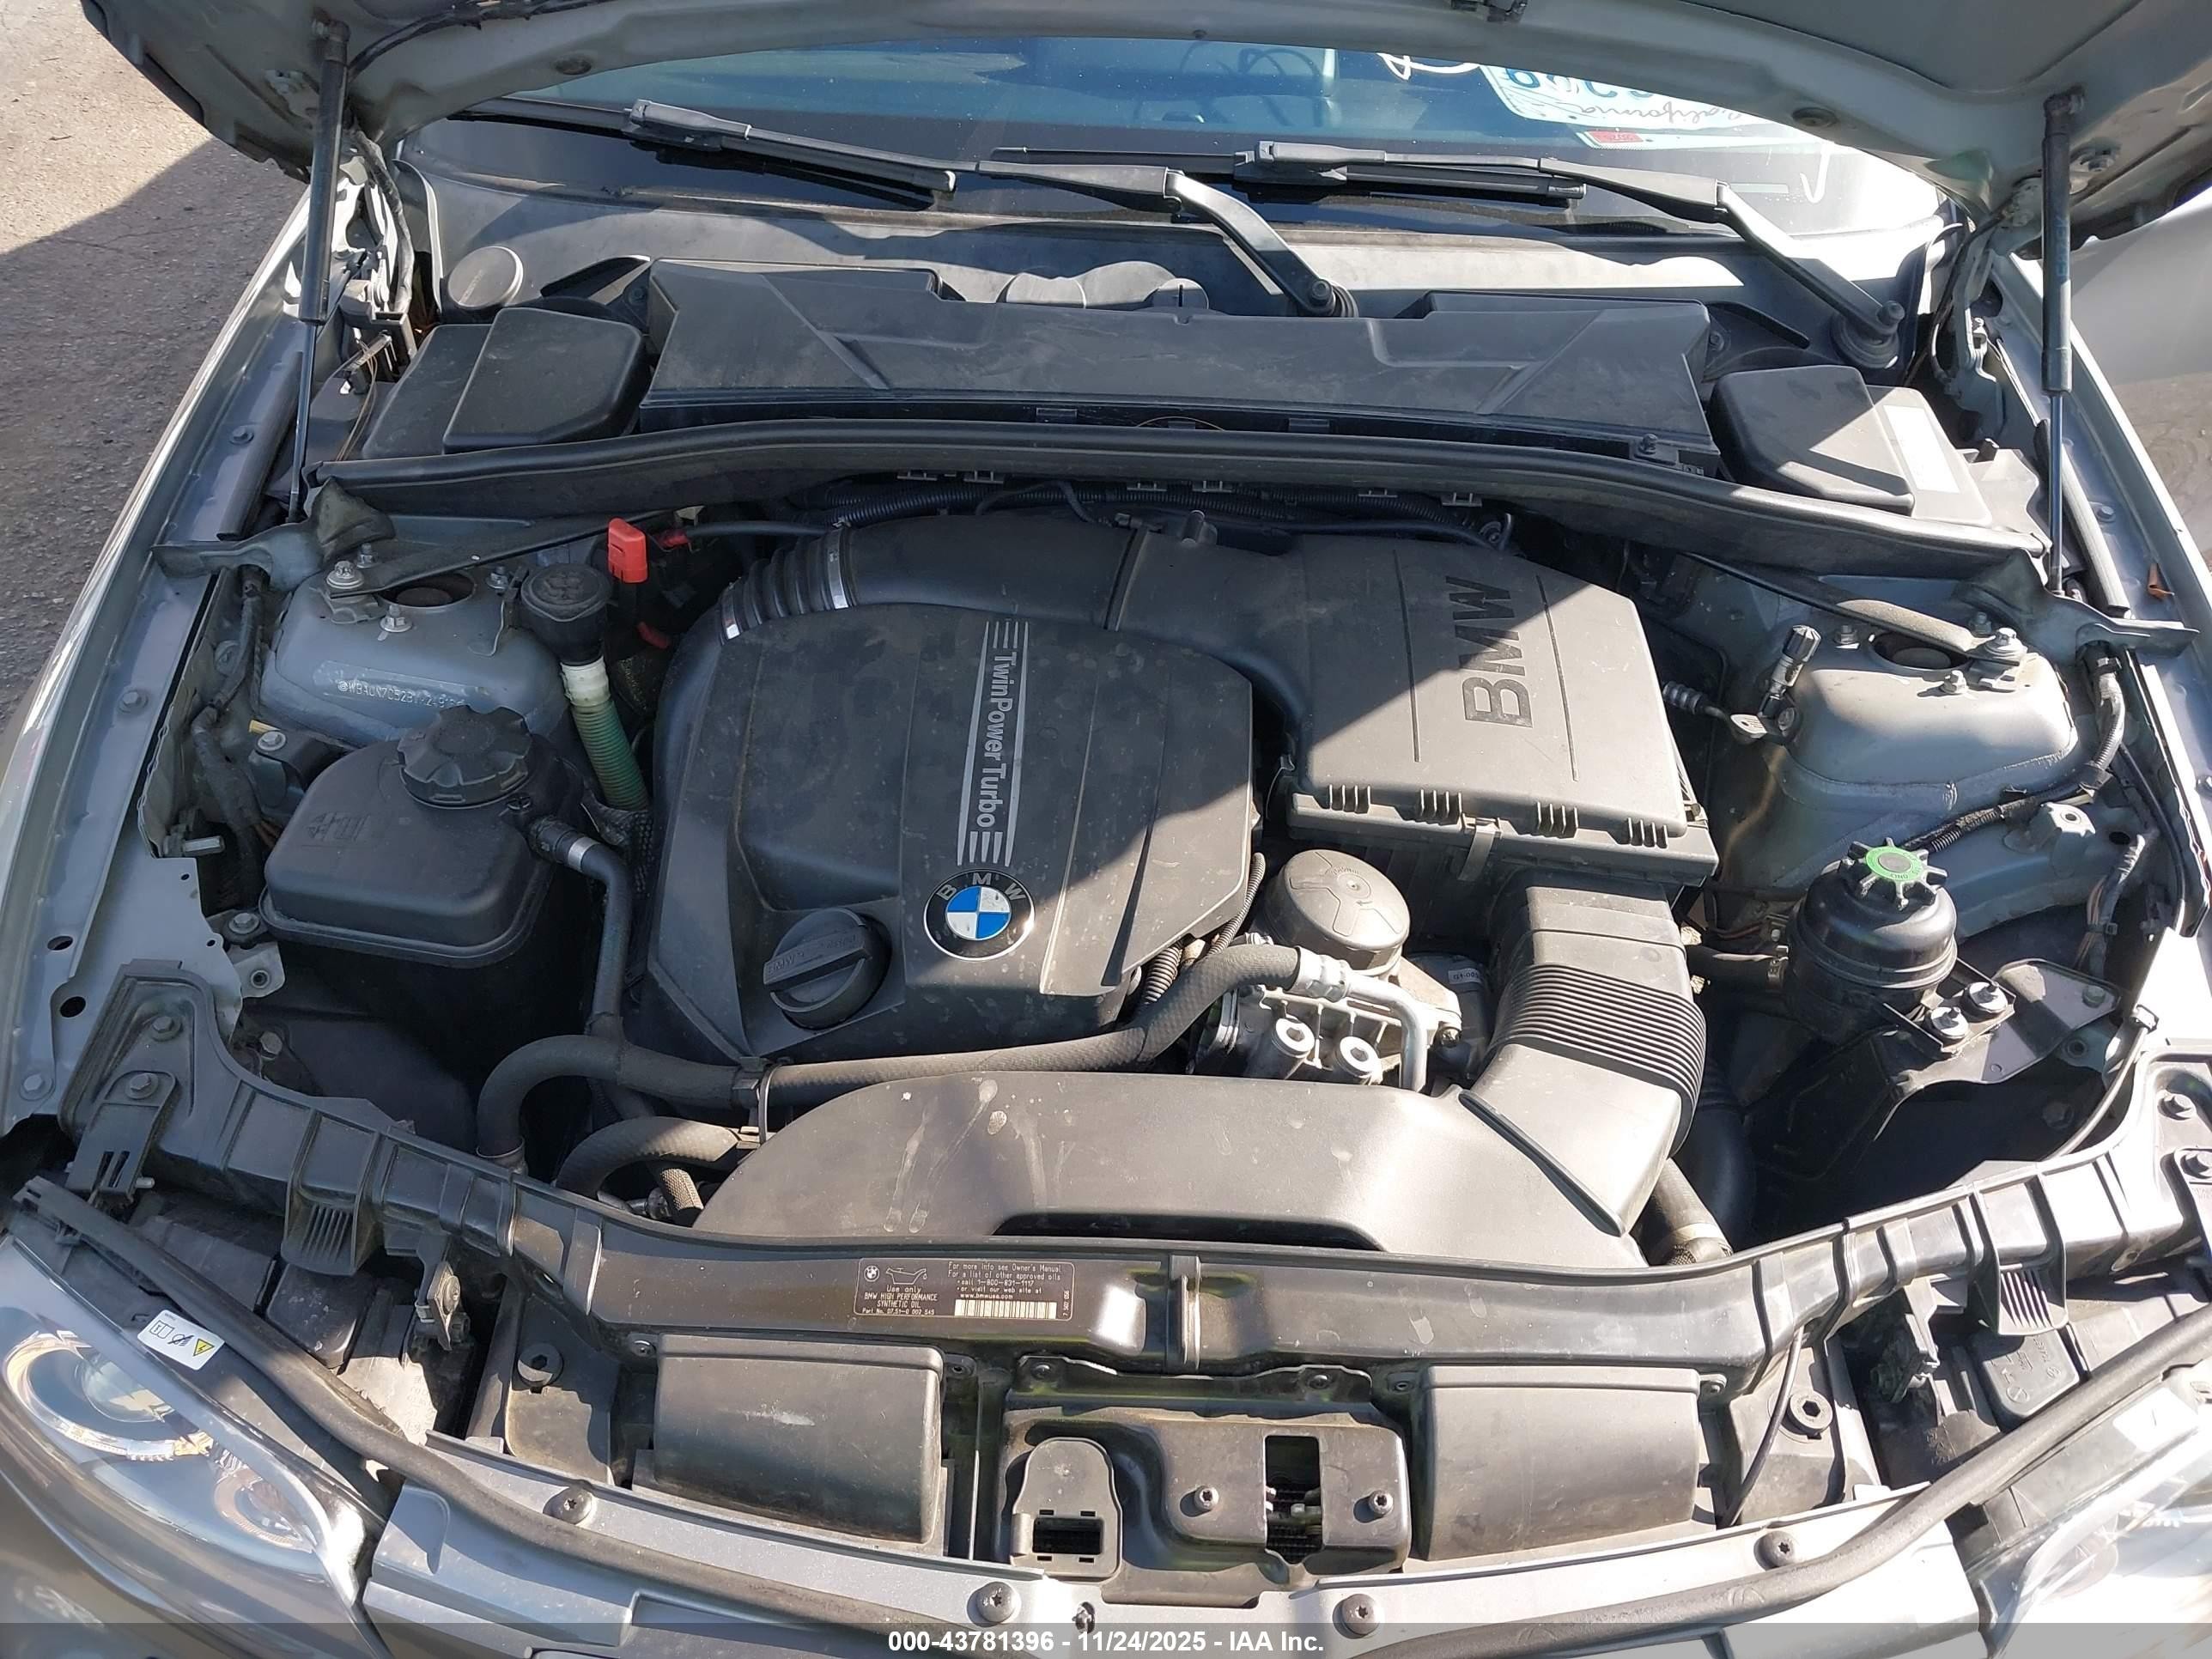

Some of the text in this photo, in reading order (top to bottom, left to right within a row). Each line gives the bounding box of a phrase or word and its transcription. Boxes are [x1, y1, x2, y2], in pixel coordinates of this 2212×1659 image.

[1445, 575, 1533, 728] BMW
[936, 872, 1026, 901] BMW
[1012, 1263, 1036, 1272] Owner's
[1040, 1264, 1061, 1273] Manual
[996, 1271, 1012, 1279] other
[1017, 1273, 1045, 1281] approved
[905, 1285, 921, 1294] only
[865, 1291, 939, 1301] BMW HIGH PERFORMANCE
[877, 1300, 908, 1309] SYNTHETIC
